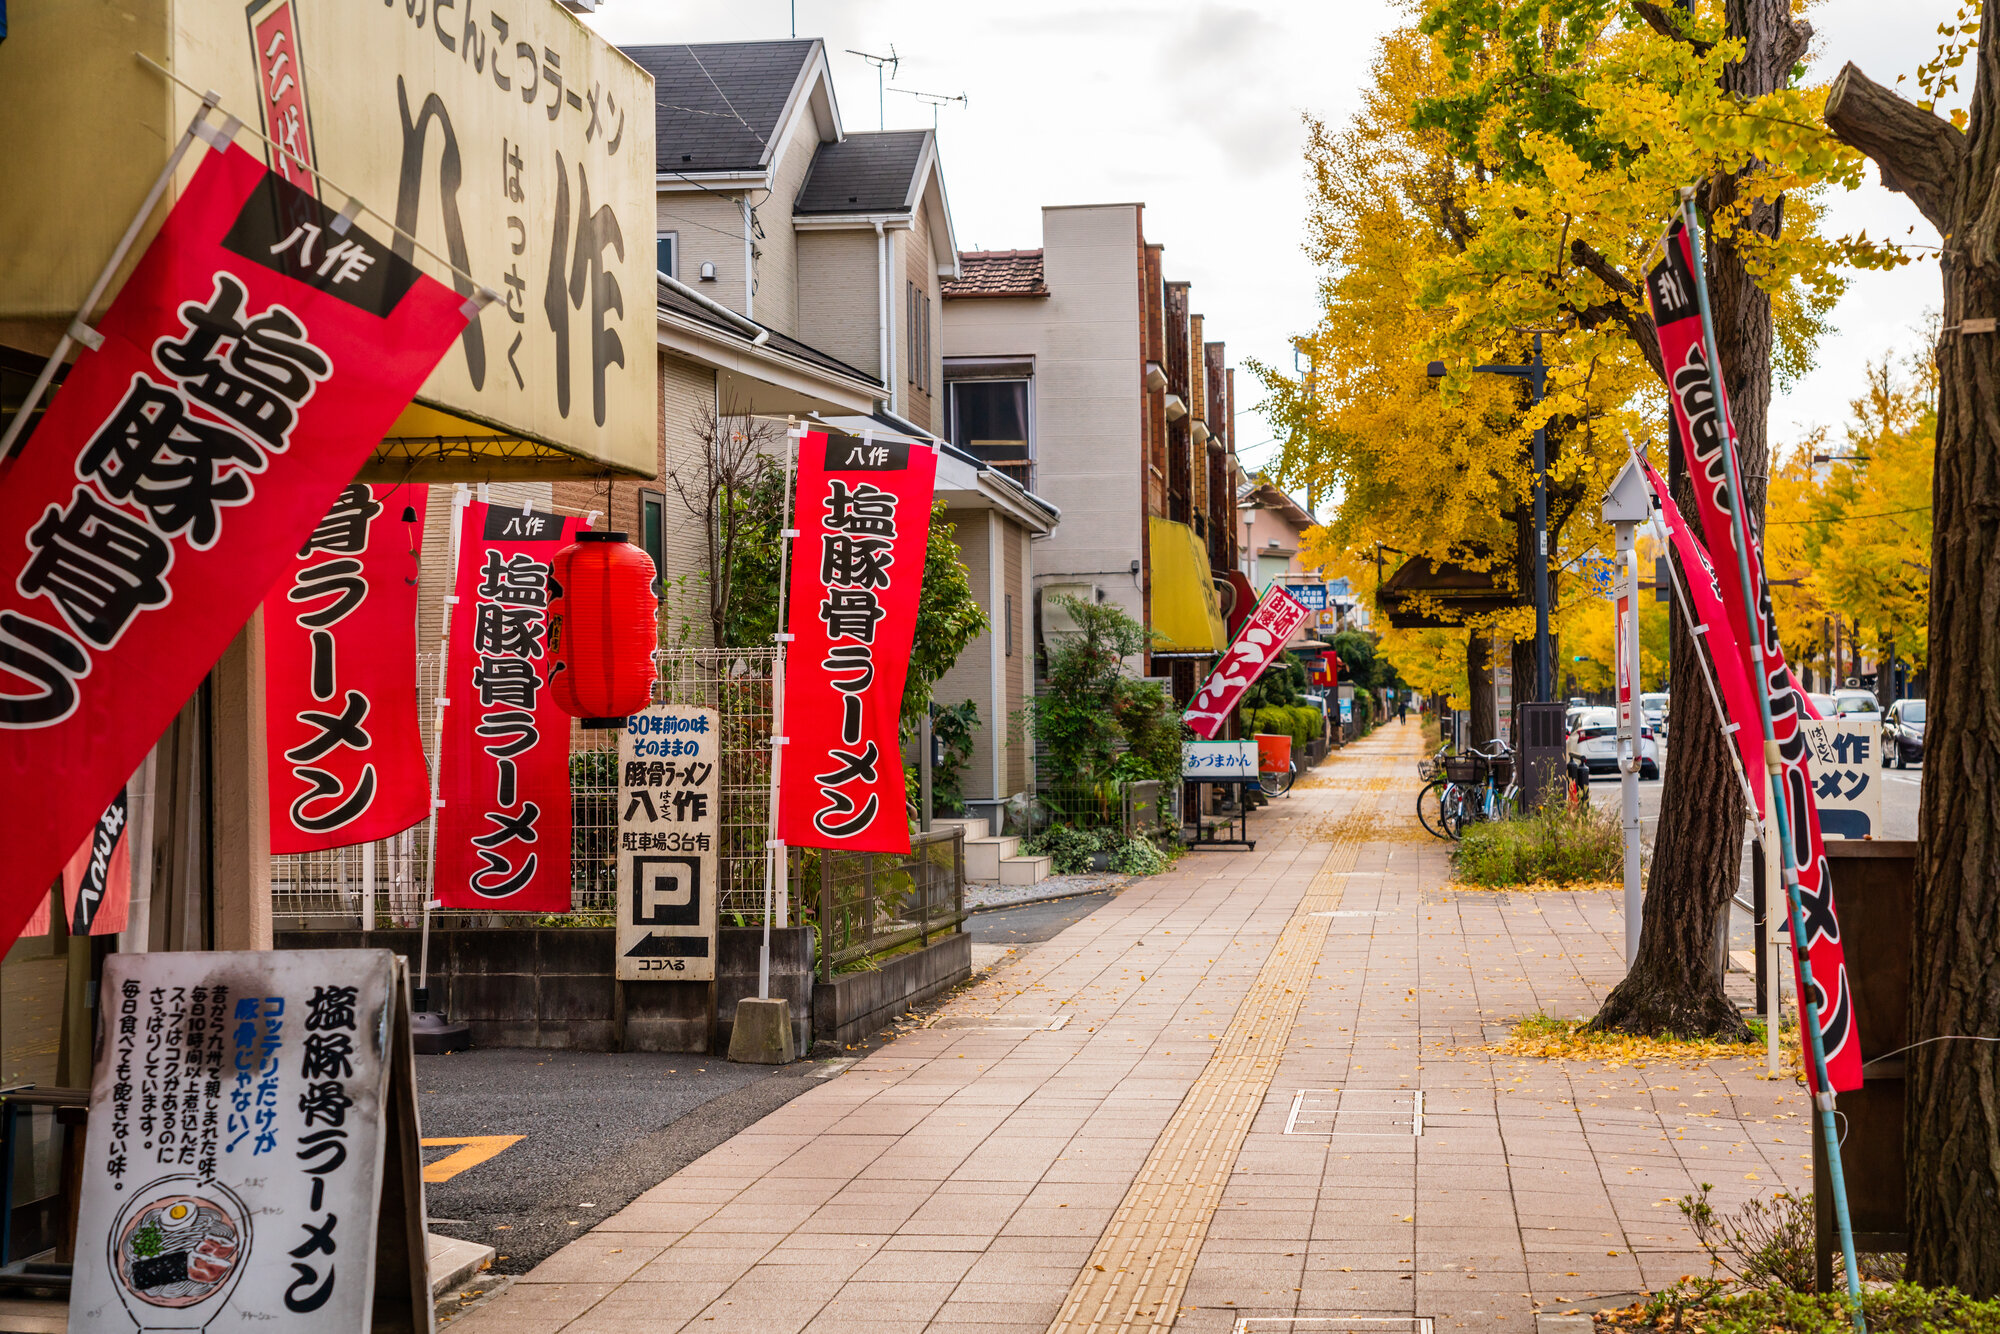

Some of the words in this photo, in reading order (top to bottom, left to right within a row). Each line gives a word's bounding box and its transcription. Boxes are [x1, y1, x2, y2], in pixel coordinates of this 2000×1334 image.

[383, 0, 625, 156] とんこつラーメン
[270, 222, 376, 284] 八作
[503, 137, 526, 391] はっさく
[845, 446, 889, 467] 八作
[502, 516, 545, 537] 八作
[813, 479, 898, 838] 塩豚骨ラーメン
[1183, 628, 1273, 721] ラーメン
[468, 548, 552, 899] 塩豚骨ラーメン
[628, 715, 710, 735] 50年前の味
[634, 738, 699, 757] そのままの
[1188, 753, 1252, 768] あづまかん
[625, 761, 712, 787] 豚骨ラーメン
[660, 790, 672, 822] はっさく
[622, 832, 711, 852] 駐車場3台有
[641, 862, 692, 919] P
[638, 959, 685, 971] ココ入る
[107, 978, 141, 1191] 毎日食べても飽きない味。
[139, 987, 168, 1149] さっぱりしています。
[157, 986, 188, 1163] スープはコクがあるのに
[177, 985, 210, 1165] 毎日10時間以上煮込んだ
[253, 997, 285, 1156] コッテリだけが
[284, 984, 359, 1314] 塩豚骨ラーメン
